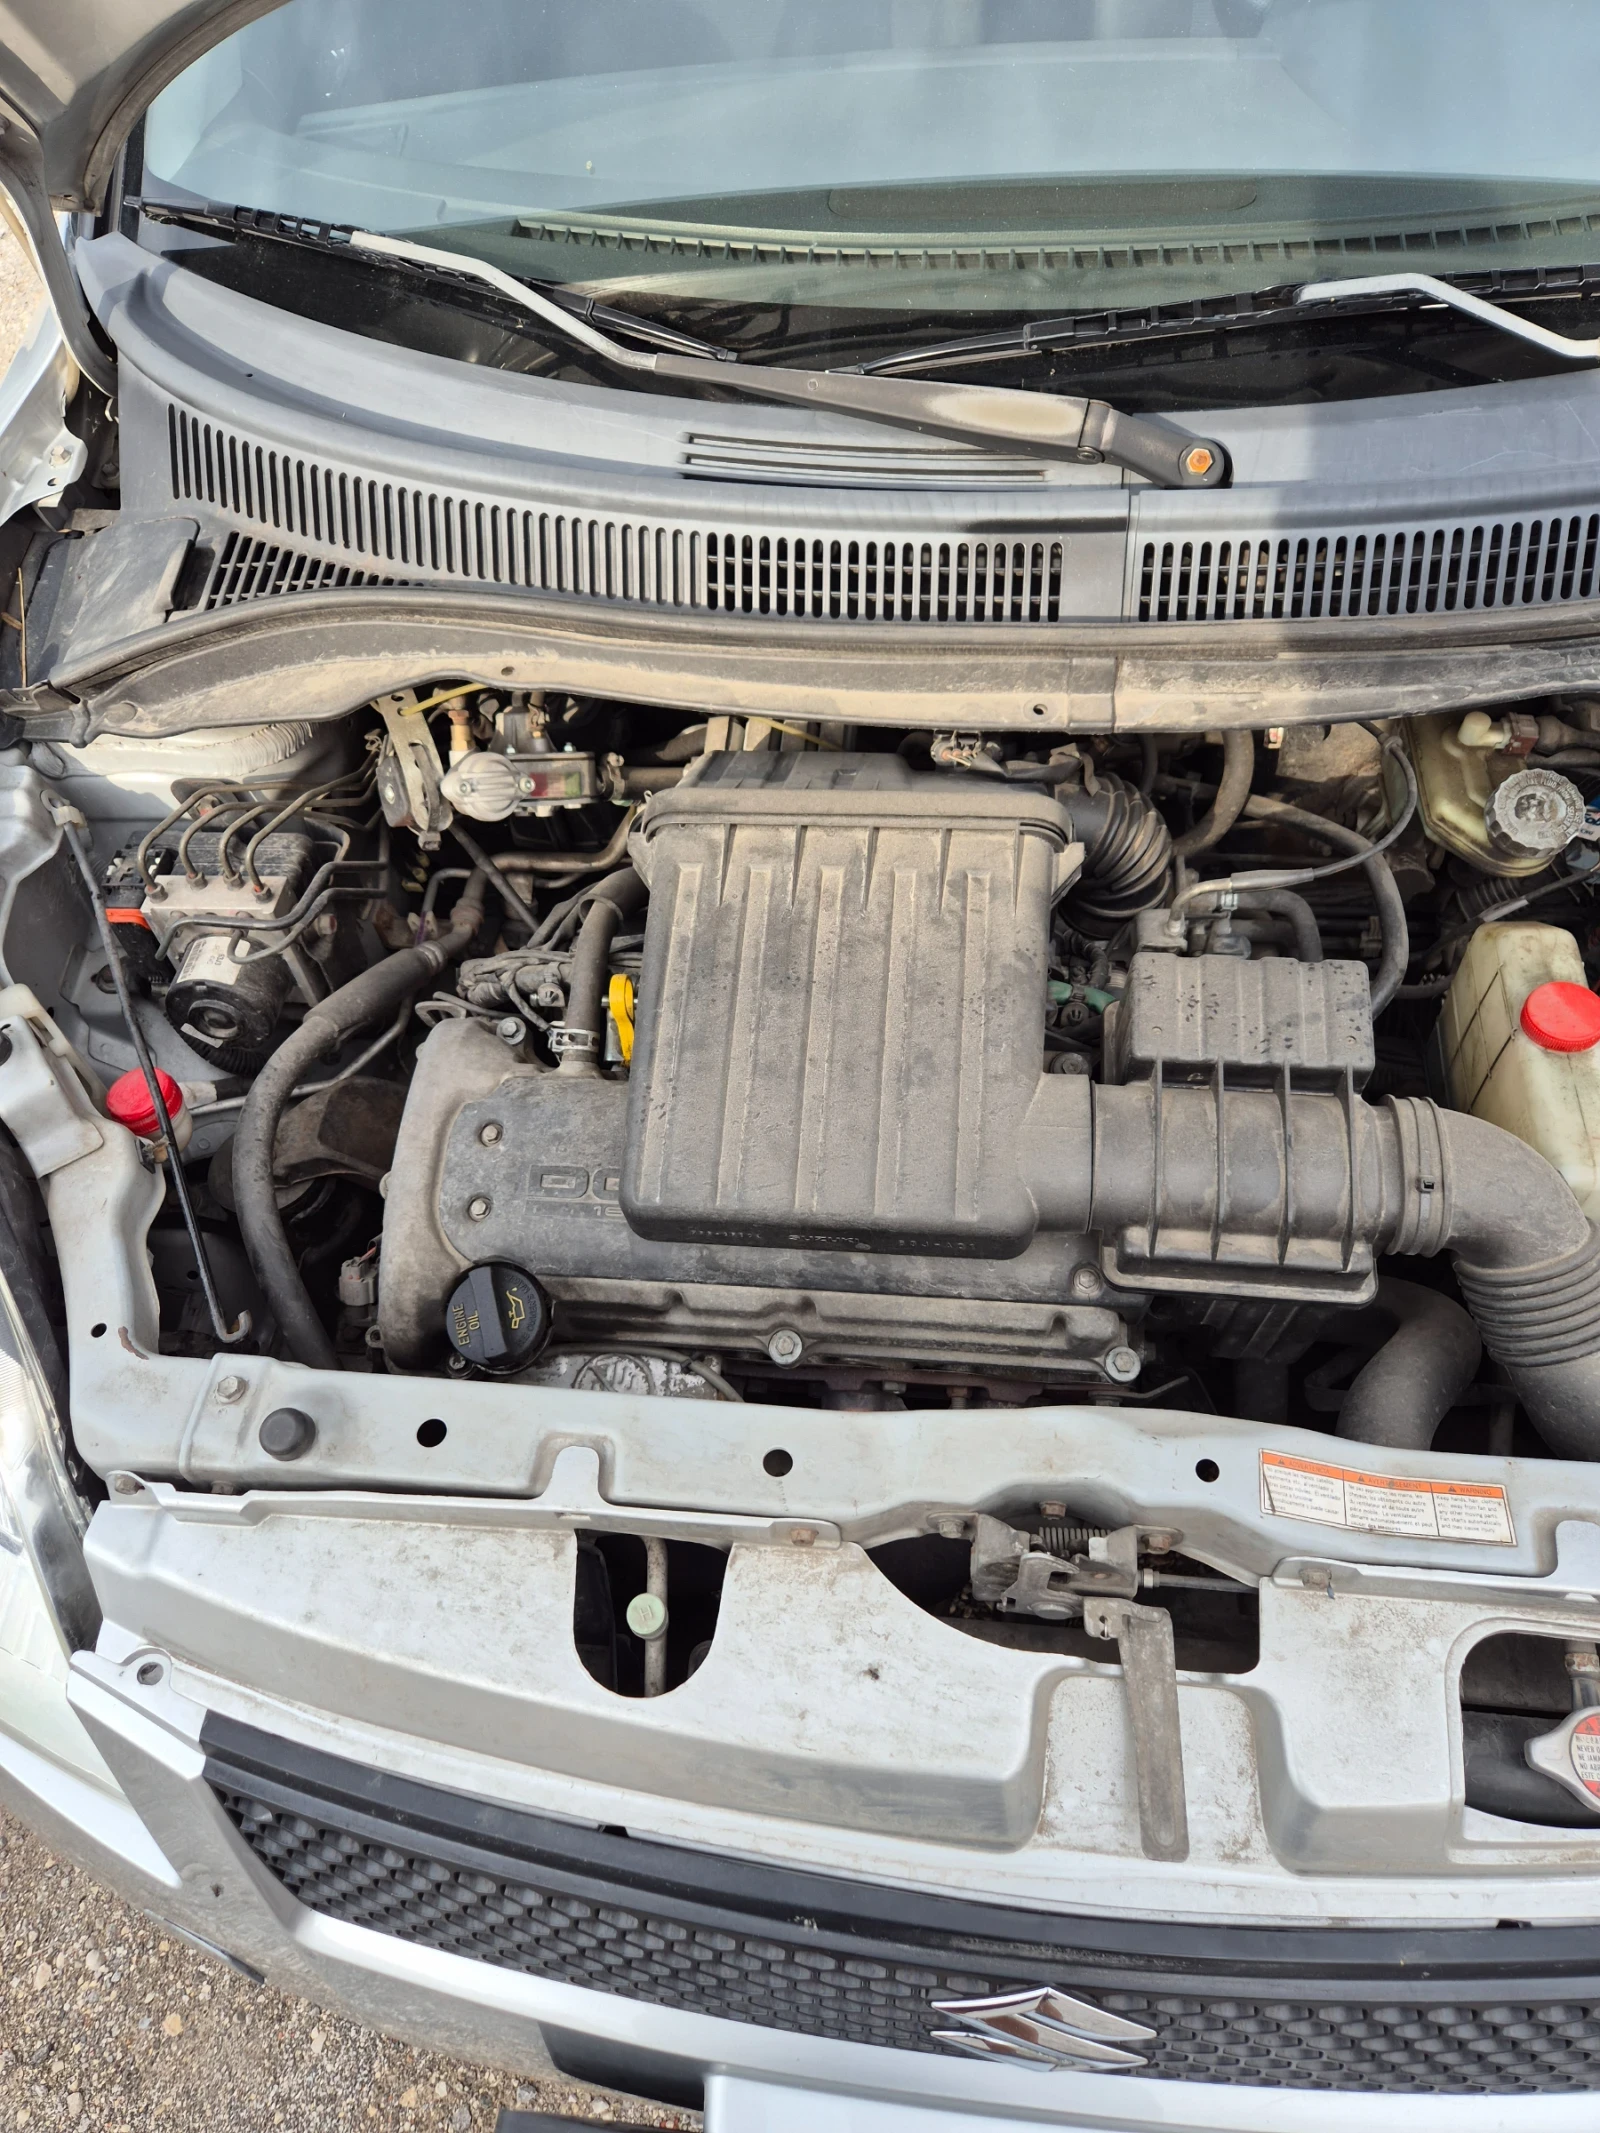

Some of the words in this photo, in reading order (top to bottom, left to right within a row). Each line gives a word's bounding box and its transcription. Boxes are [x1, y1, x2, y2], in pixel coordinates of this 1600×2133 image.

[452, 1303, 470, 1346] ENGINE
[467, 1310, 480, 1330] OIL
[1290, 1460, 1330, 1474] ADVERTENCIA
[1368, 1478, 1422, 1490] AVERTSEMENT
[1460, 1486, 1492, 1496] WARNING
[639, 1604, 655, 1622] H
[1576, 1744, 1594, 1754] NEVER
[1582, 1772, 1594, 1780] ESTE
